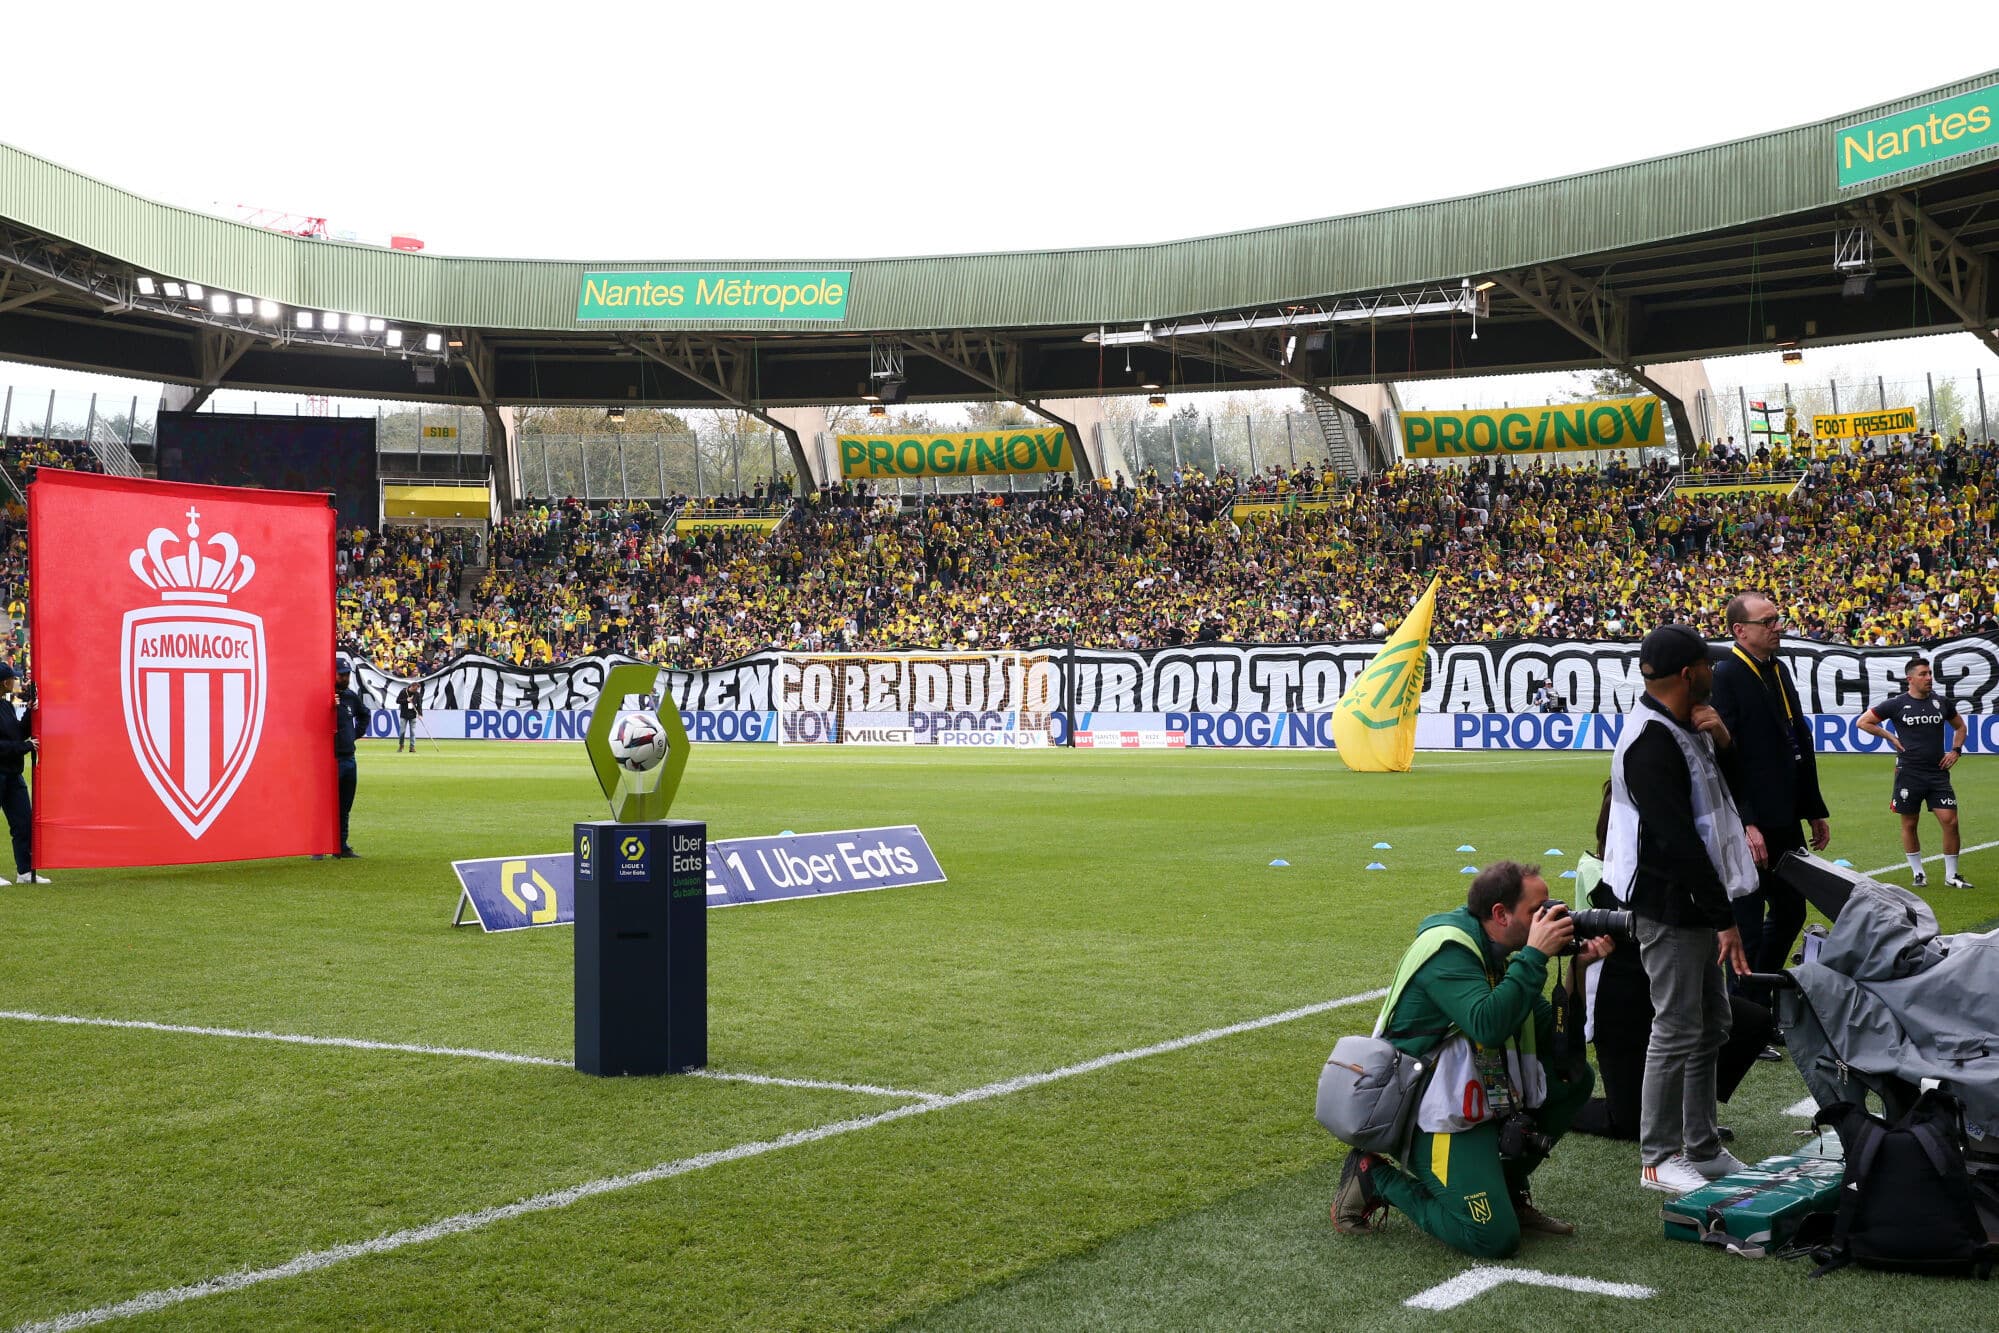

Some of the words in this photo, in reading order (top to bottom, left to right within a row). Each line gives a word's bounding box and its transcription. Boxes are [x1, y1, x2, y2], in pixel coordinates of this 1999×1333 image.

[1843, 105, 1992, 169] Nantes
[583, 279, 685, 306] Nantes
[1815, 418, 1847, 436] FOOT
[1853, 411, 1915, 434] PASSION
[159, 633, 234, 659] MONACO
[844, 729, 911, 743] MILLET
[672, 834, 702, 852] Uber
[672, 855, 702, 873] Eats
[726, 851, 756, 891] 1
[756, 847, 843, 889] Uber
[836, 841, 920, 881] Eats
